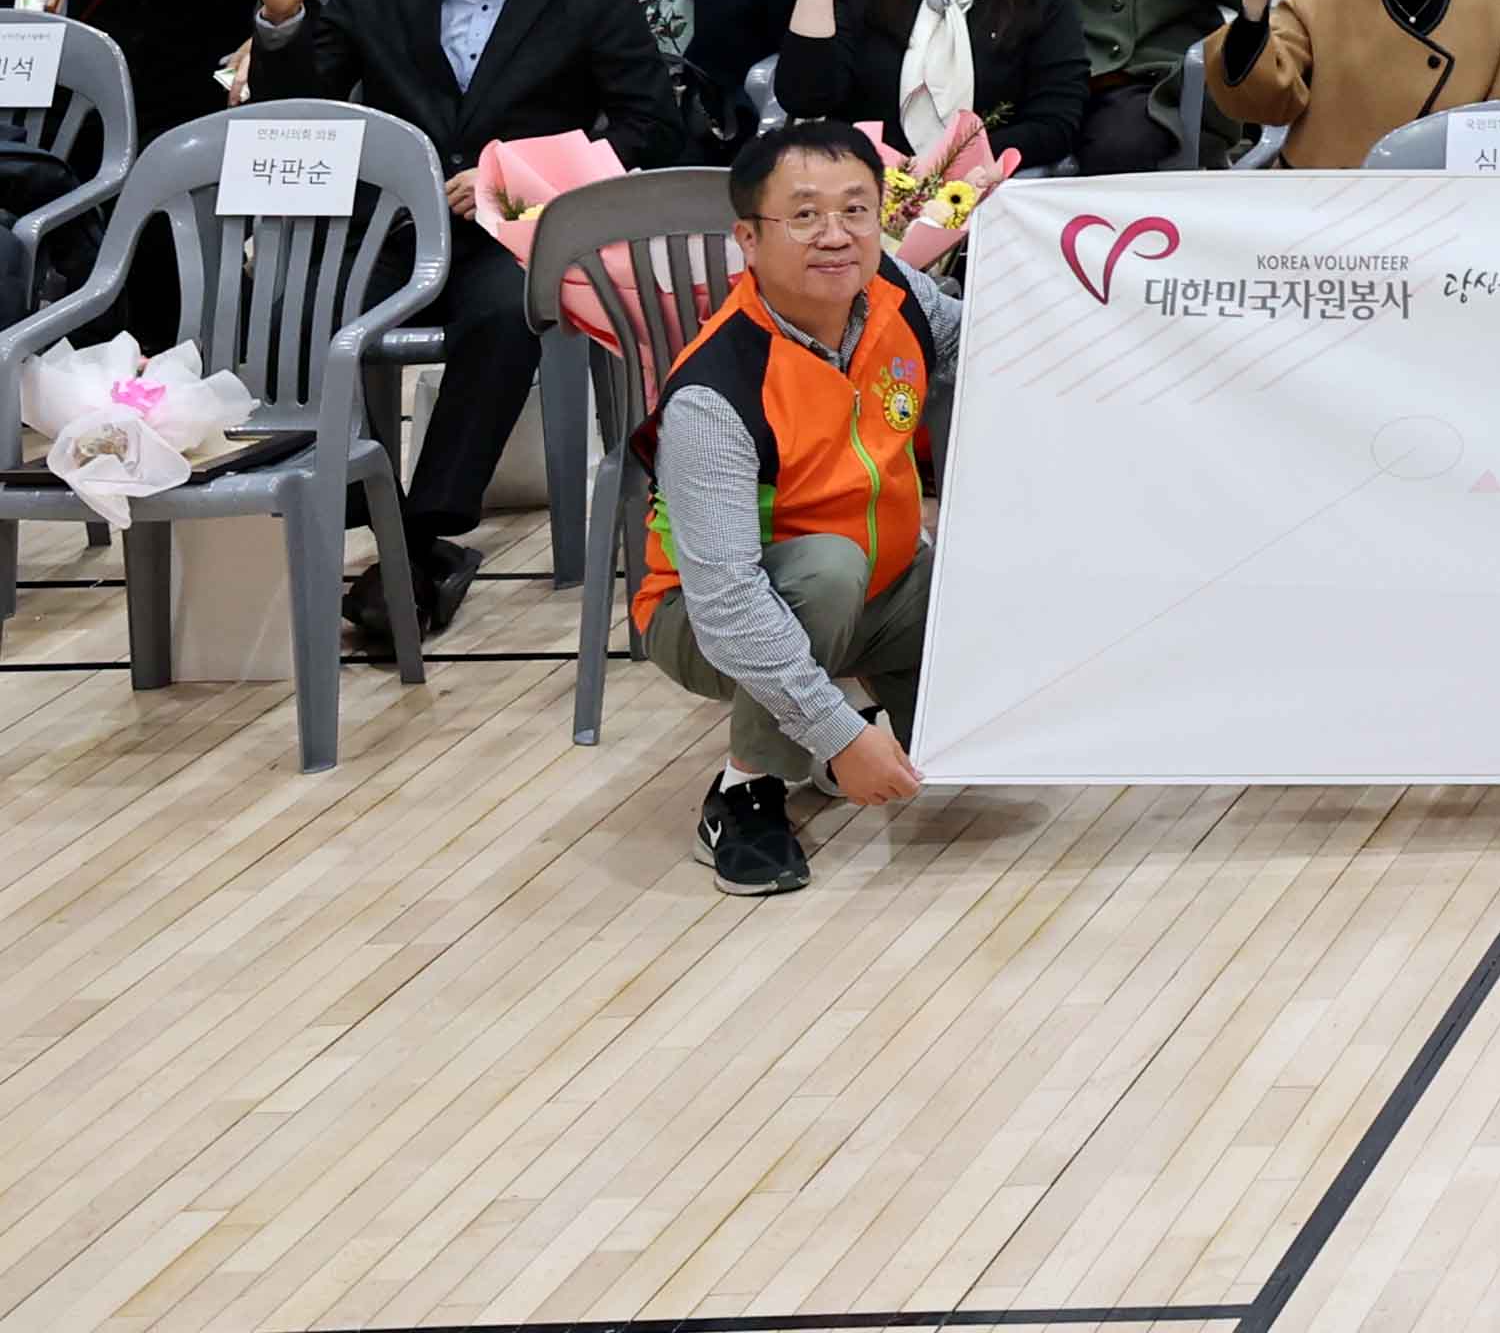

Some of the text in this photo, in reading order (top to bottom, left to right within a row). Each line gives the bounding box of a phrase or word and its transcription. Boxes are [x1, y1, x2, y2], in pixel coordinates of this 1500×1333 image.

[252, 157, 332, 186] 박판순
[1256, 254, 1409, 271] KOREA VOLUNTEER
[1143, 277, 1414, 321] 대한민국자원봉사
